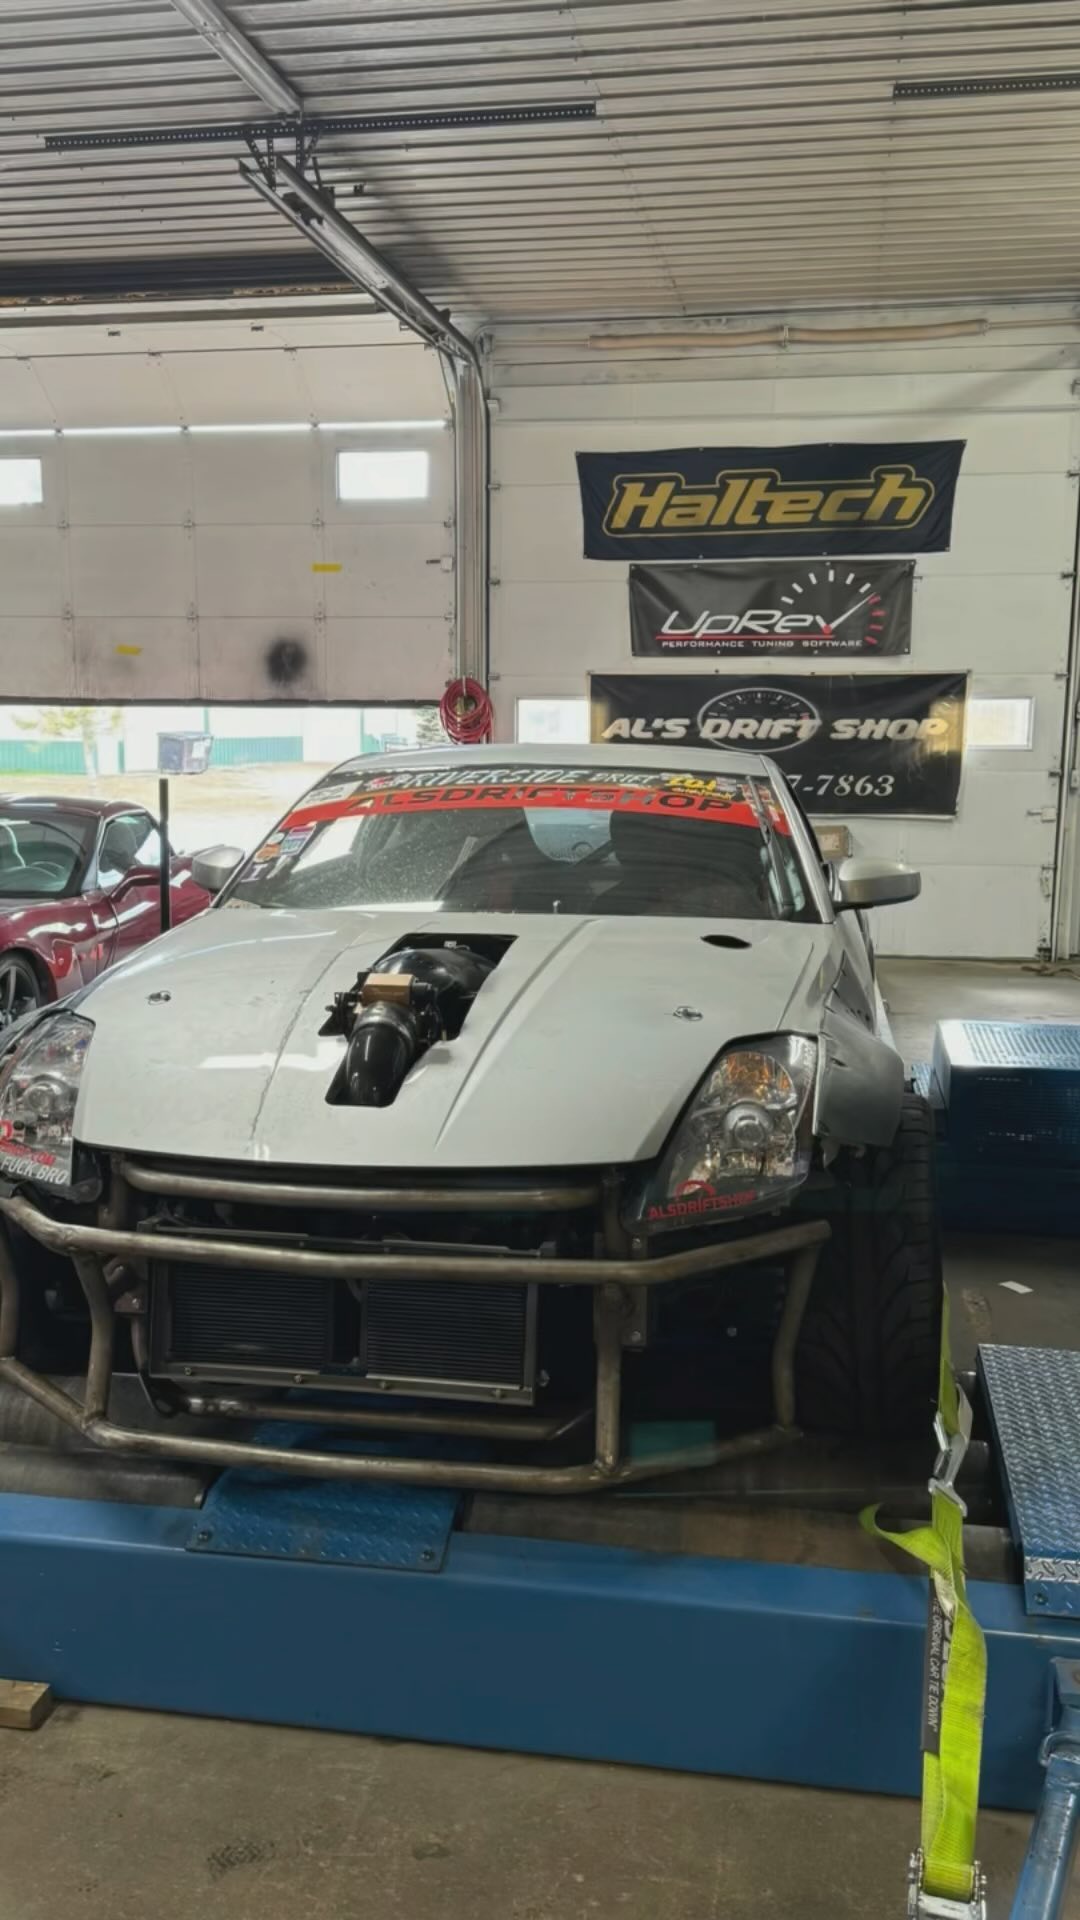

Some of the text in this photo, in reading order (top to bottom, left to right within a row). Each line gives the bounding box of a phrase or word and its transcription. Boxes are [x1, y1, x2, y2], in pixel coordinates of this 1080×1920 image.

[611, 472, 927, 529] Haltech
[661, 605, 845, 639] UpRev
[661, 640, 863, 648] PERFORMANCE TUNING SOFTWARE
[601, 717, 950, 740] AL'S DRIFT SHOP
[345, 786, 733, 811] ALSDRIFTSHOP
[0, 1156, 38, 1177] FUCK
[36, 1166, 69, 1185] BRO
[930, 1614, 942, 1656] ORIGINAL
[929, 1658, 940, 1678] CAR
[928, 1679, 939, 1694] TIE
